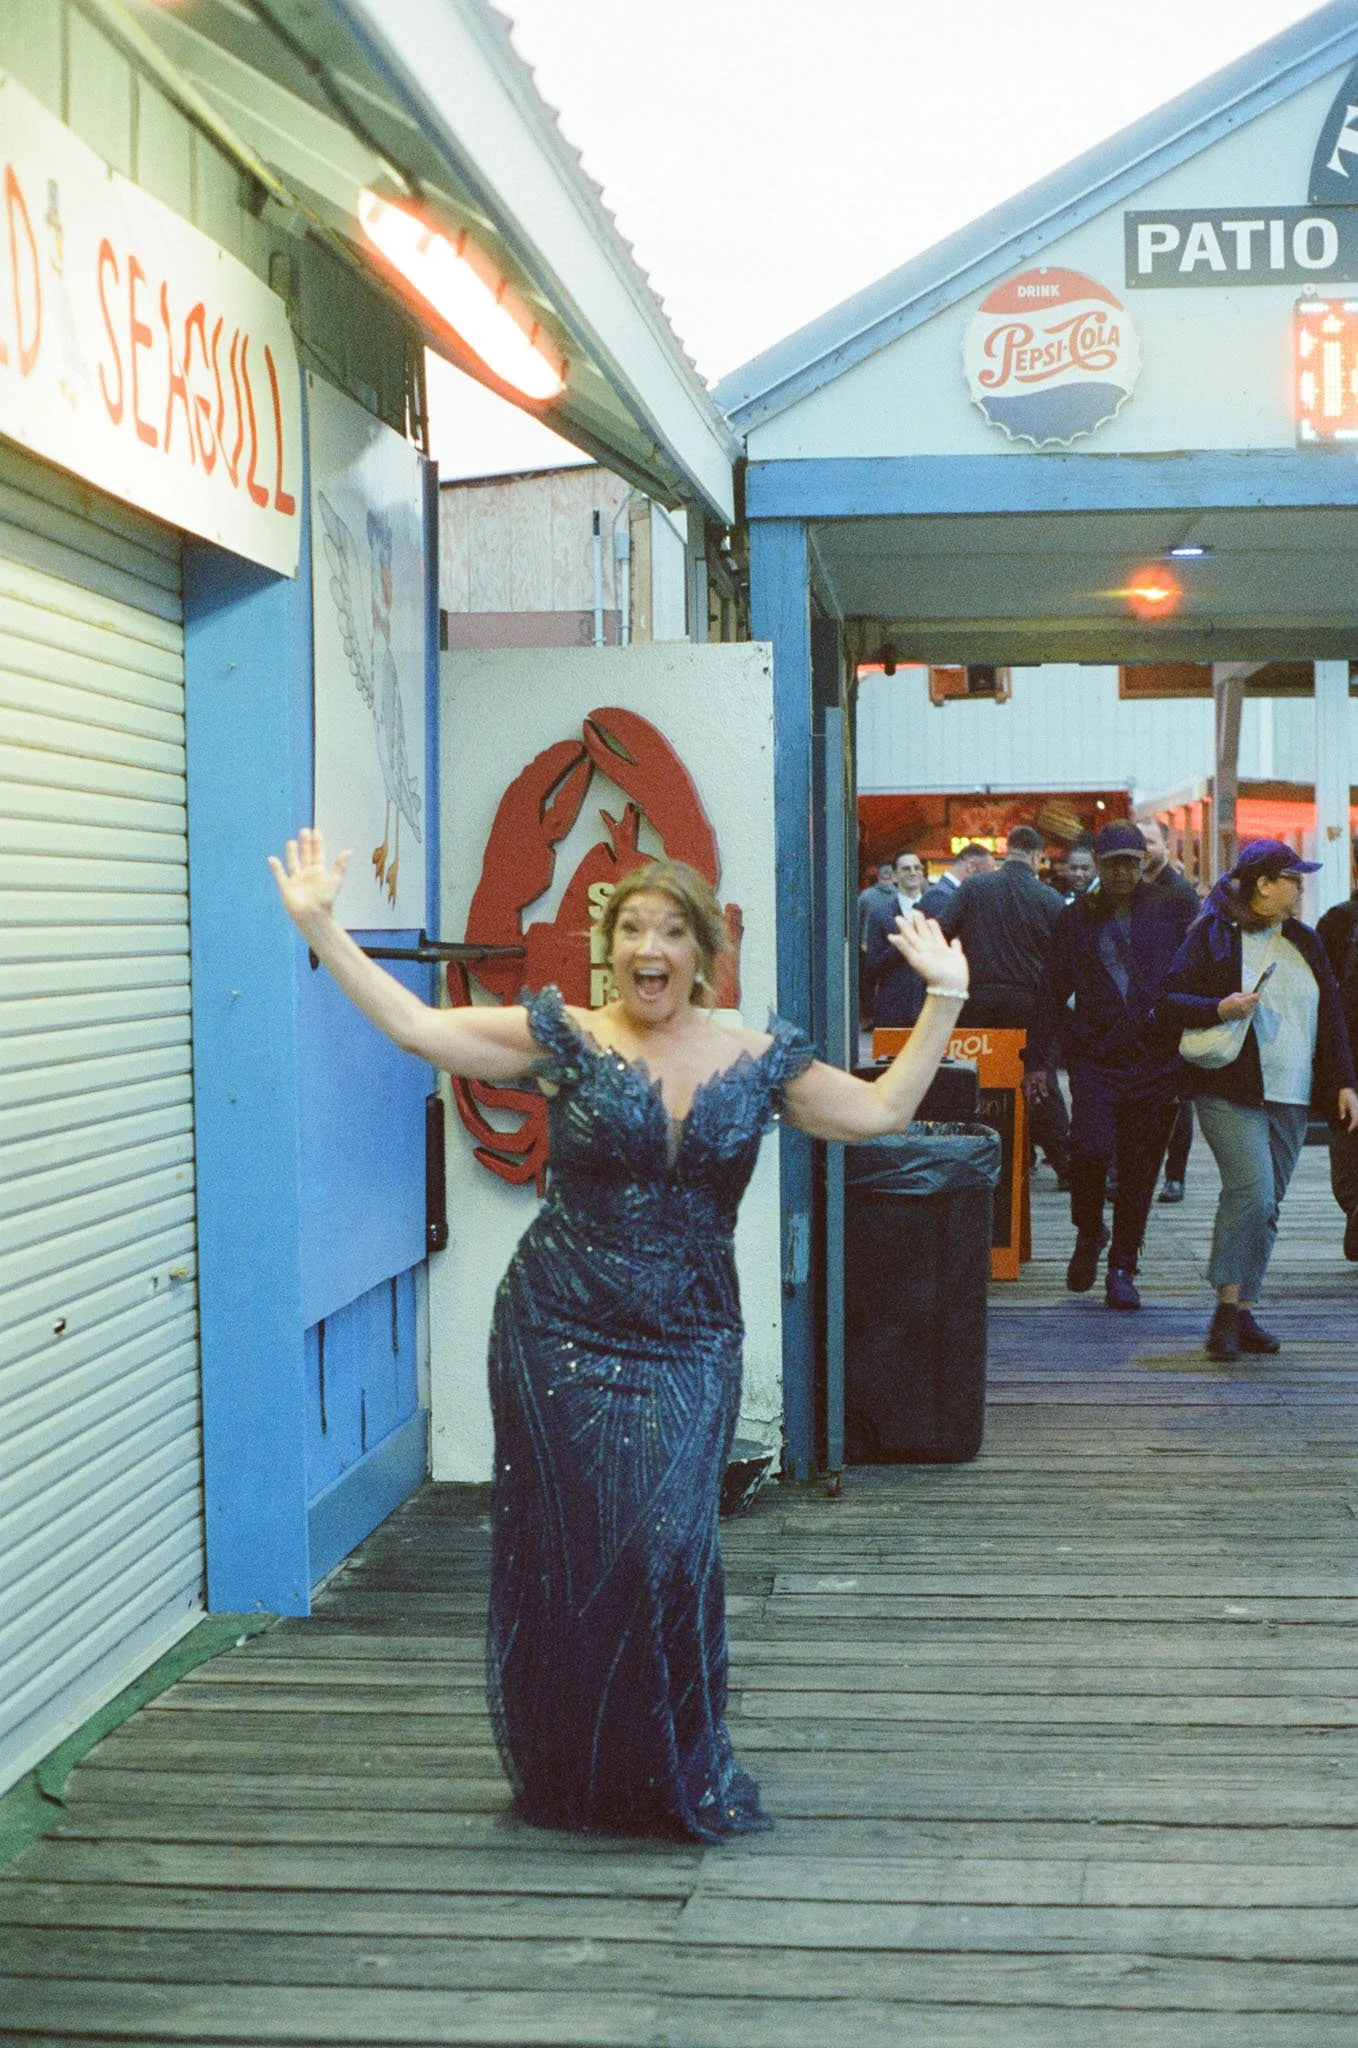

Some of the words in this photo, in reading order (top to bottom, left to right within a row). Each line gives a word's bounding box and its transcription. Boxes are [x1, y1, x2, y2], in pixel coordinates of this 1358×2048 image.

[1137, 217, 1339, 275] PATIO
[1017, 284, 1061, 298] DRINK
[98, 236, 296, 517] SEAGULL
